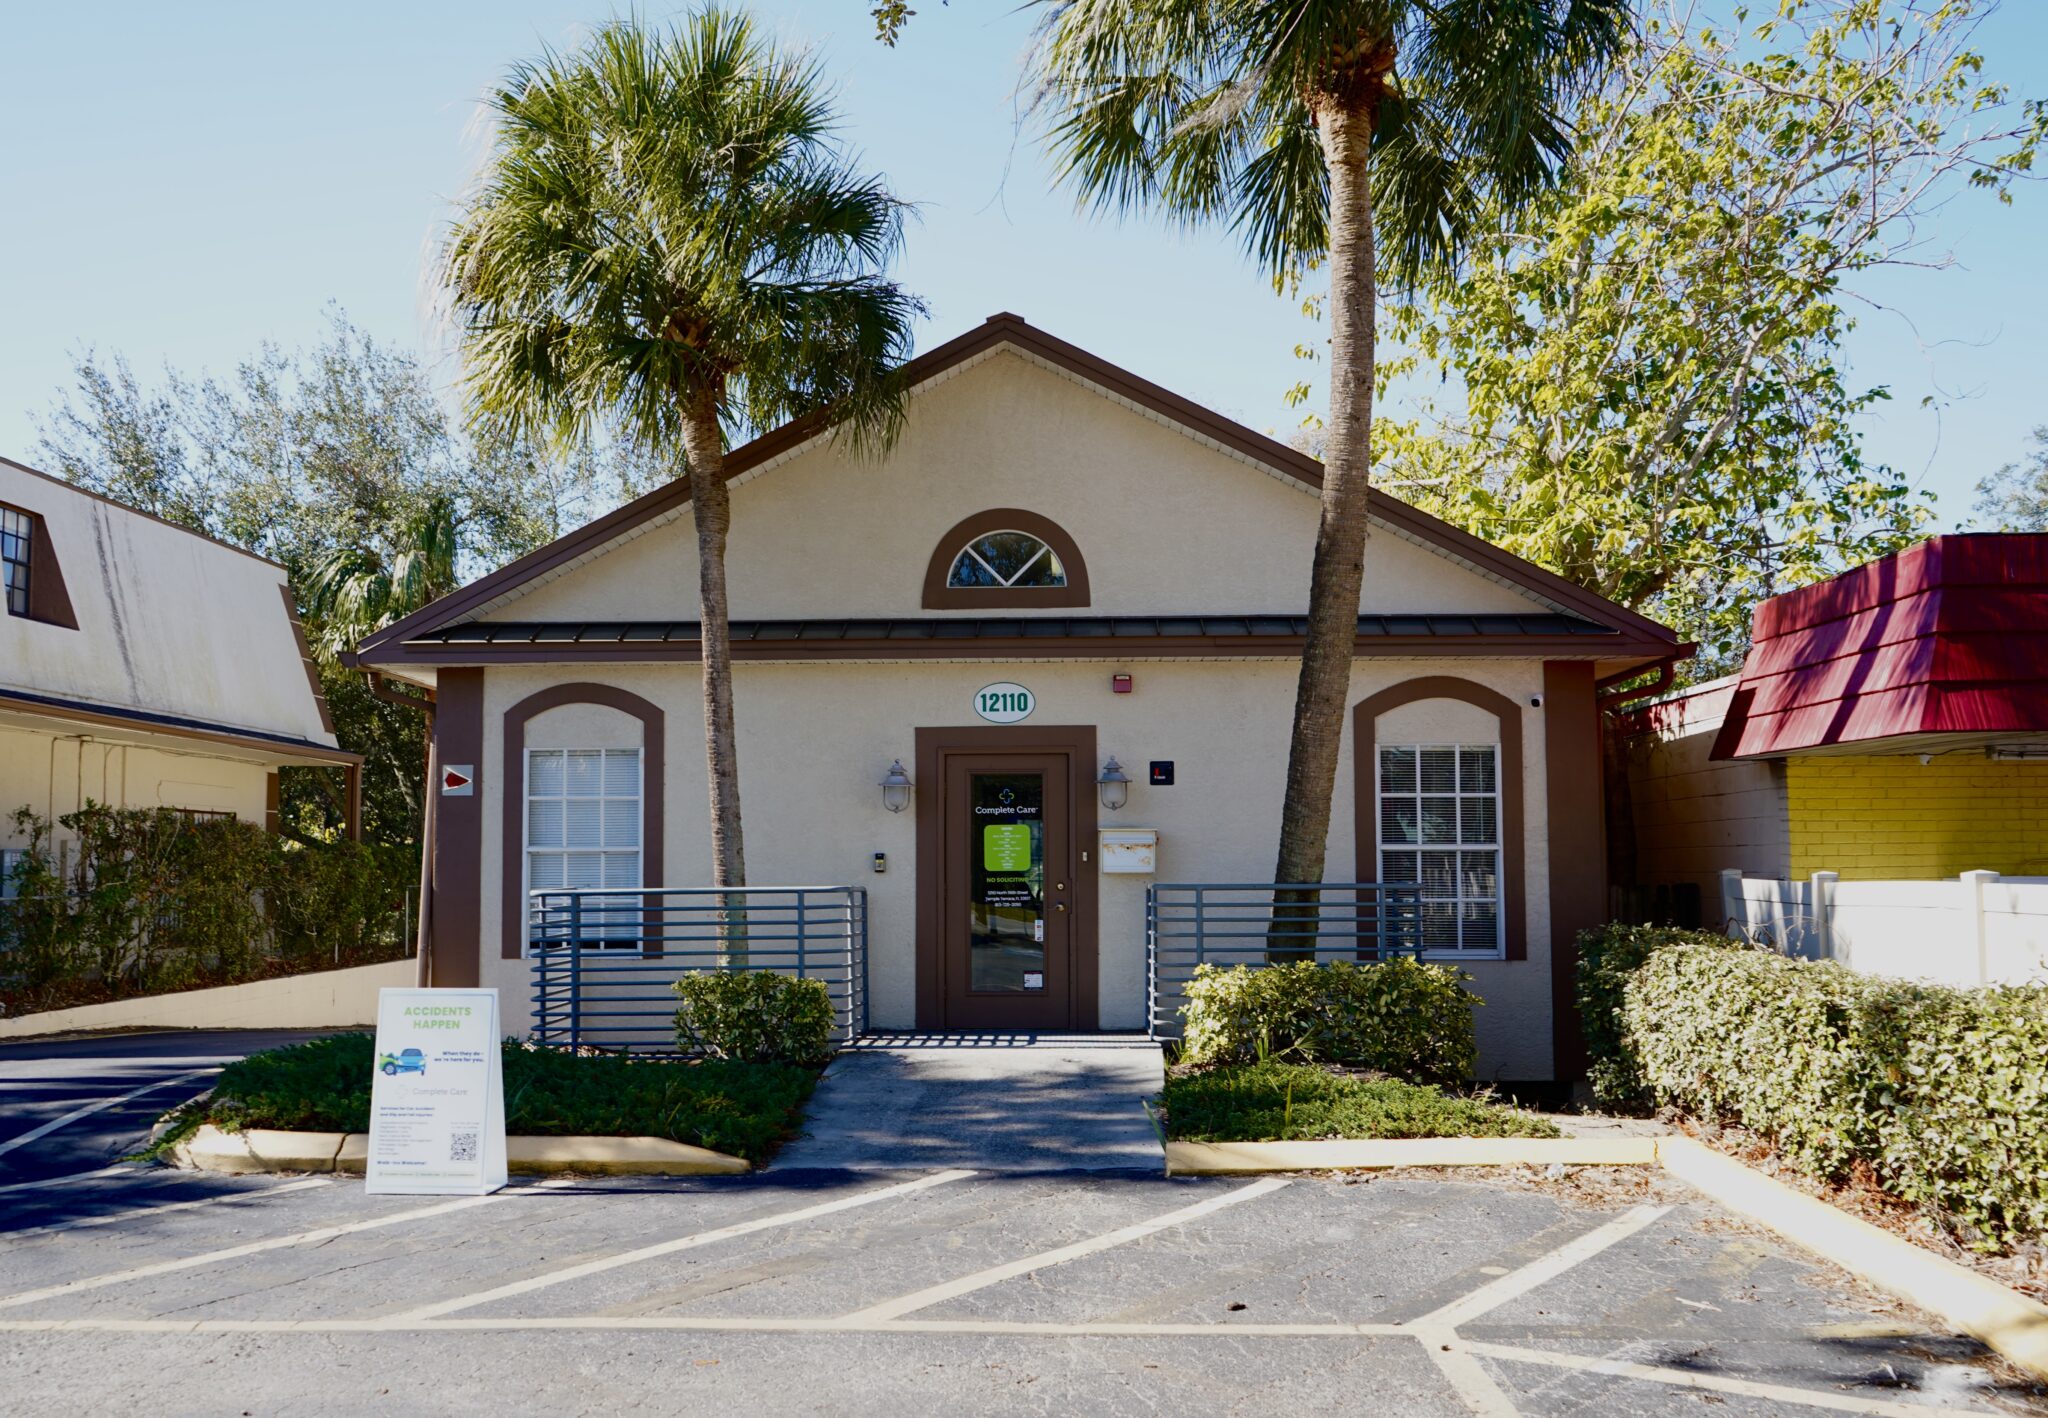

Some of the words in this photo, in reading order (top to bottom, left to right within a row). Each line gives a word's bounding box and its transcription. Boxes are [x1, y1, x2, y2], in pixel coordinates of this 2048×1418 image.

[980, 692, 1028, 712] 12110
[975, 806, 1015, 815] Complete
[404, 1007, 472, 1016] ACCIDENTS
[413, 1019, 460, 1029] HAPPEN
[412, 1087, 448, 1096] Complete
[449, 1087, 468, 1096] Care
